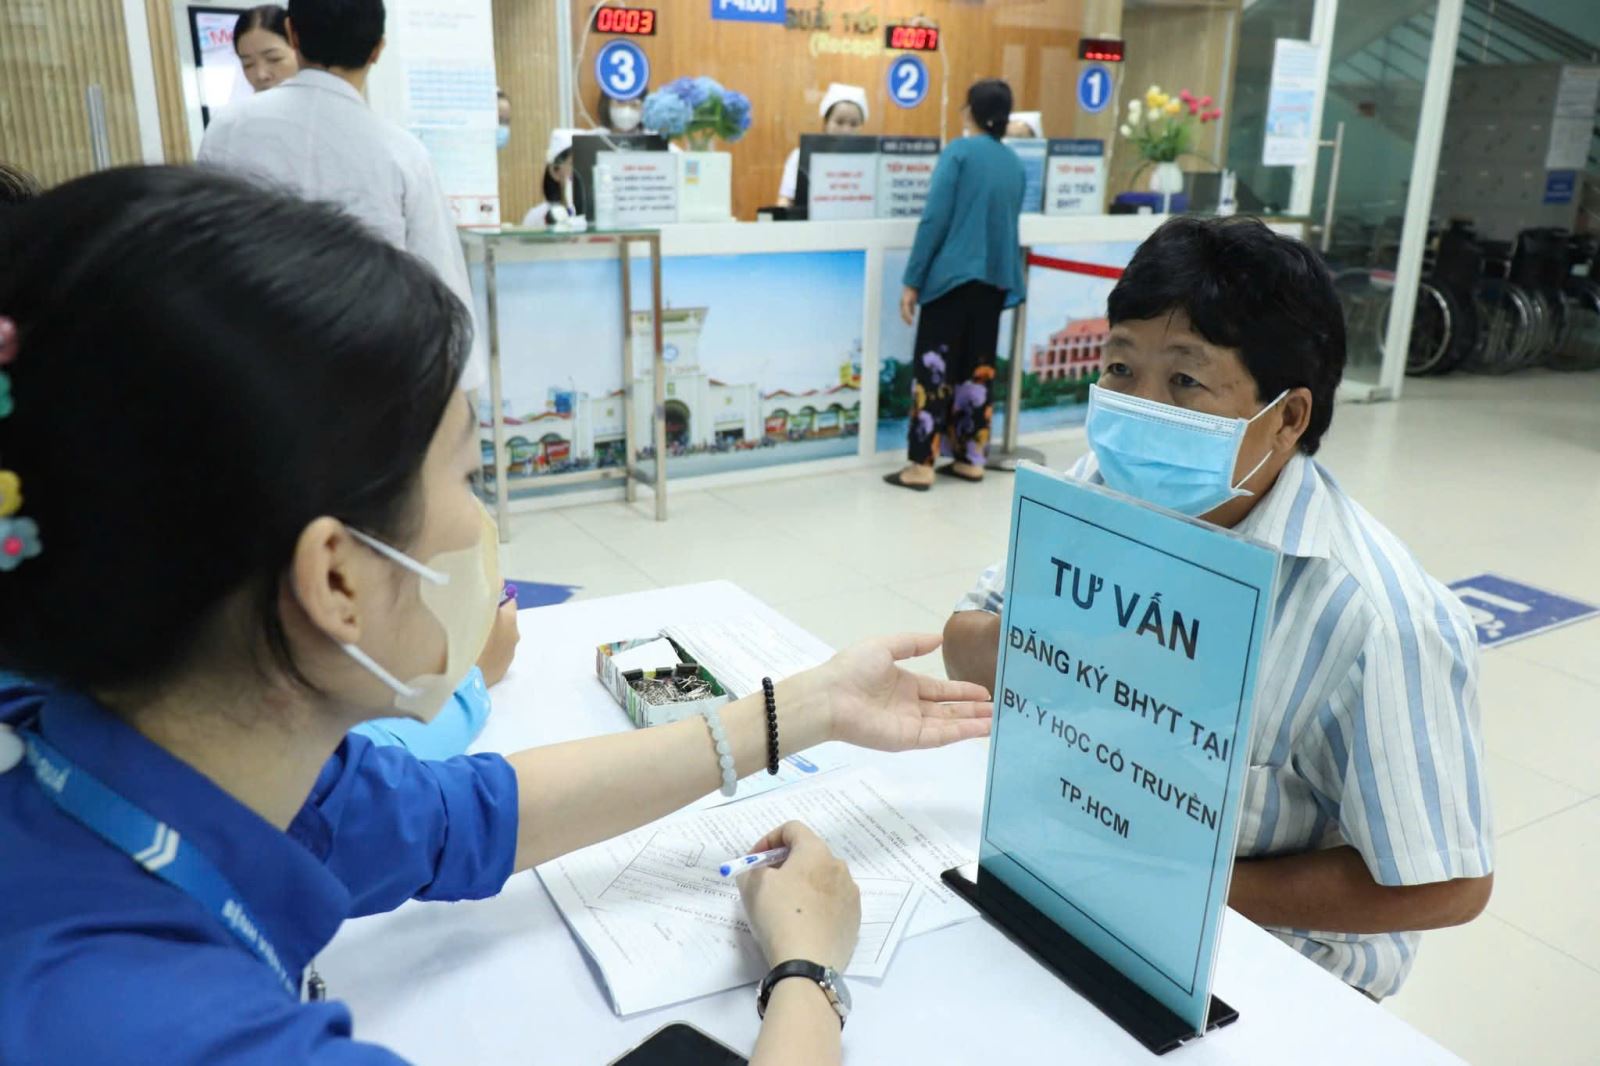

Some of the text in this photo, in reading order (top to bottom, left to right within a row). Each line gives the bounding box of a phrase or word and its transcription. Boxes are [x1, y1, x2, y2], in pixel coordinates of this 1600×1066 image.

[597, 7, 654, 34] 0003
[891, 26, 938, 50] 0007
[610, 49, 636, 91] 3
[897, 63, 919, 99] 2
[1087, 73, 1101, 106] 1
[1051, 557, 1200, 661] TƯ VẤN
[1010, 626, 1229, 762] ĐĂNG KÝ BHYT TẠI
[1004, 687, 1029, 718] BV.
[1036, 705, 1048, 726] Y
[1051, 715, 1090, 753] HỌC
[1131, 761, 1217, 831] TRUYỀN
[1060, 776, 1129, 839] TP.HCM
